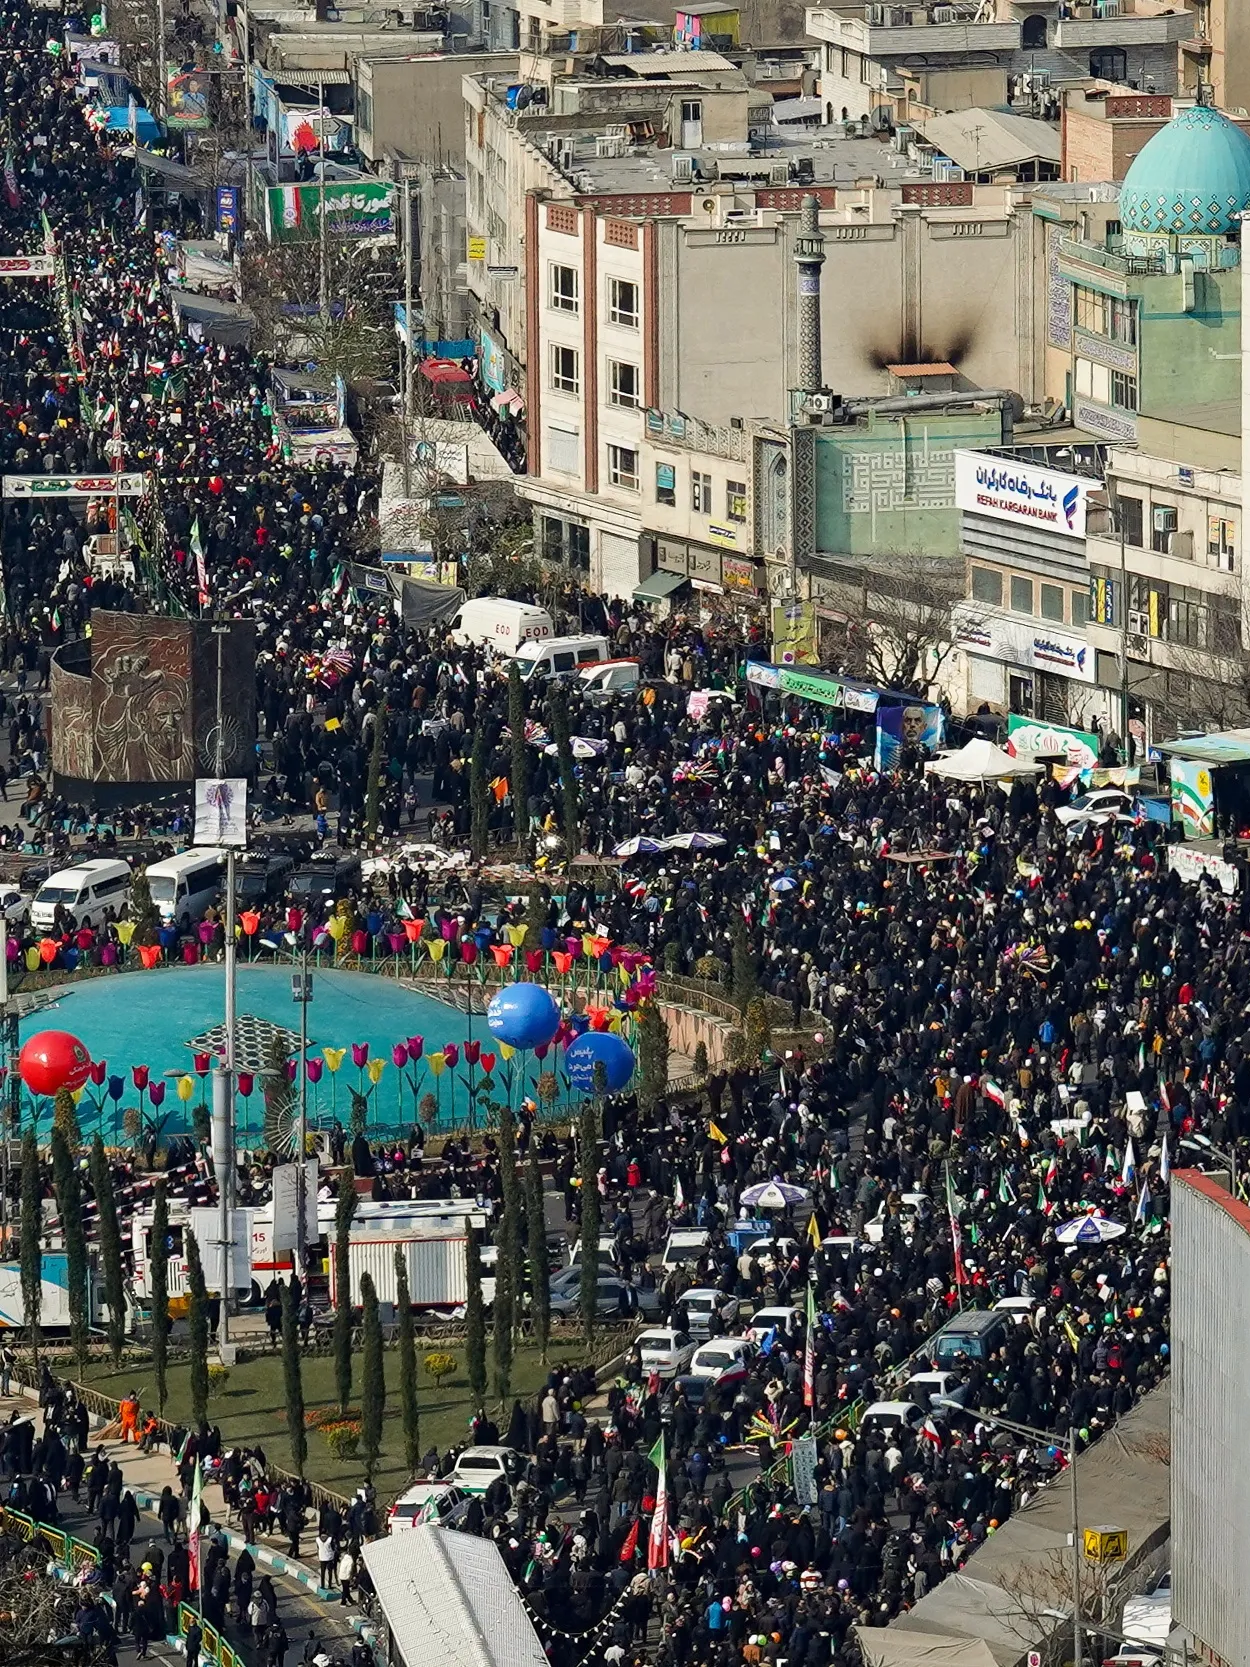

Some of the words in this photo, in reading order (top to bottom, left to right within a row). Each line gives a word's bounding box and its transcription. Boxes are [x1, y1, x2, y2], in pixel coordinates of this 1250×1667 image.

[976, 465, 1008, 491] کارگران
[1008, 475, 1032, 500] رفاه
[1032, 480, 1057, 507] بانک
[976, 493, 999, 508] REFAH
[1000, 499, 1038, 519] KARGARAN
[1038, 510, 1058, 523] BANK
[496, 624, 510, 635] EOD
[525, 626, 549, 637] EOD
[570, 1046, 594, 1060] پلیس
